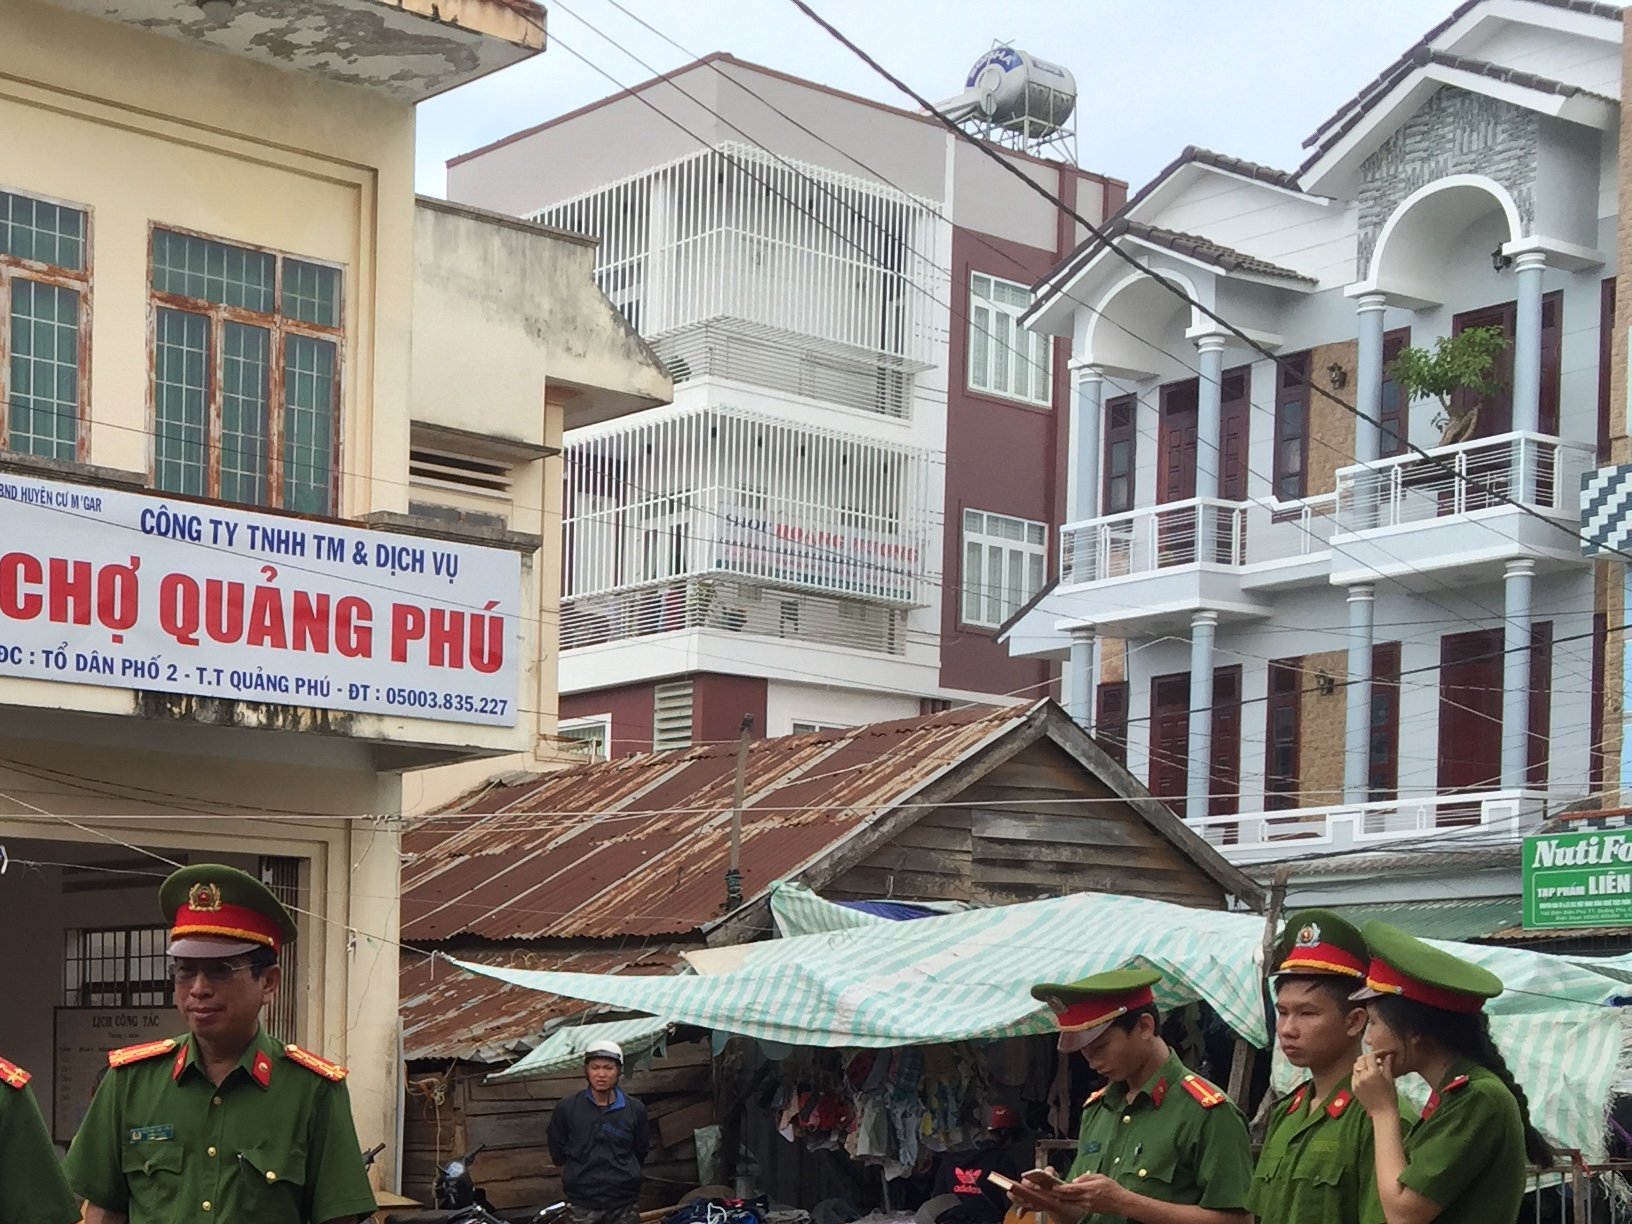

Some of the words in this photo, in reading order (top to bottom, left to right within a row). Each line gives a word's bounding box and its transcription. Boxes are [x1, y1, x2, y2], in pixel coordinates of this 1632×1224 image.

[140, 504, 202, 543] CÔNG
[209, 518, 239, 547] TY
[247, 524, 306, 557] TNHH
[312, 534, 345, 563] TM
[352, 540, 368, 566] &
[376, 543, 424, 576] DỊCH
[432, 551, 459, 584] VỤ
[159, 564, 374, 659] QUẢNG
[391, 600, 504, 674] PHÚ
[41, 641, 69, 671] TỔ
[75, 650, 114, 675] DÂN
[121, 655, 162, 680] PHỐ
[166, 664, 178, 682] 2
[196, 667, 224, 687] T.T
[230, 665, 289, 694] QUẢNG
[295, 676, 331, 698] PHÚ
[348, 683, 370, 702] ĐT
[386, 687, 508, 716] 05003.835.227
[1588, 871, 1631, 895] LIÊN
